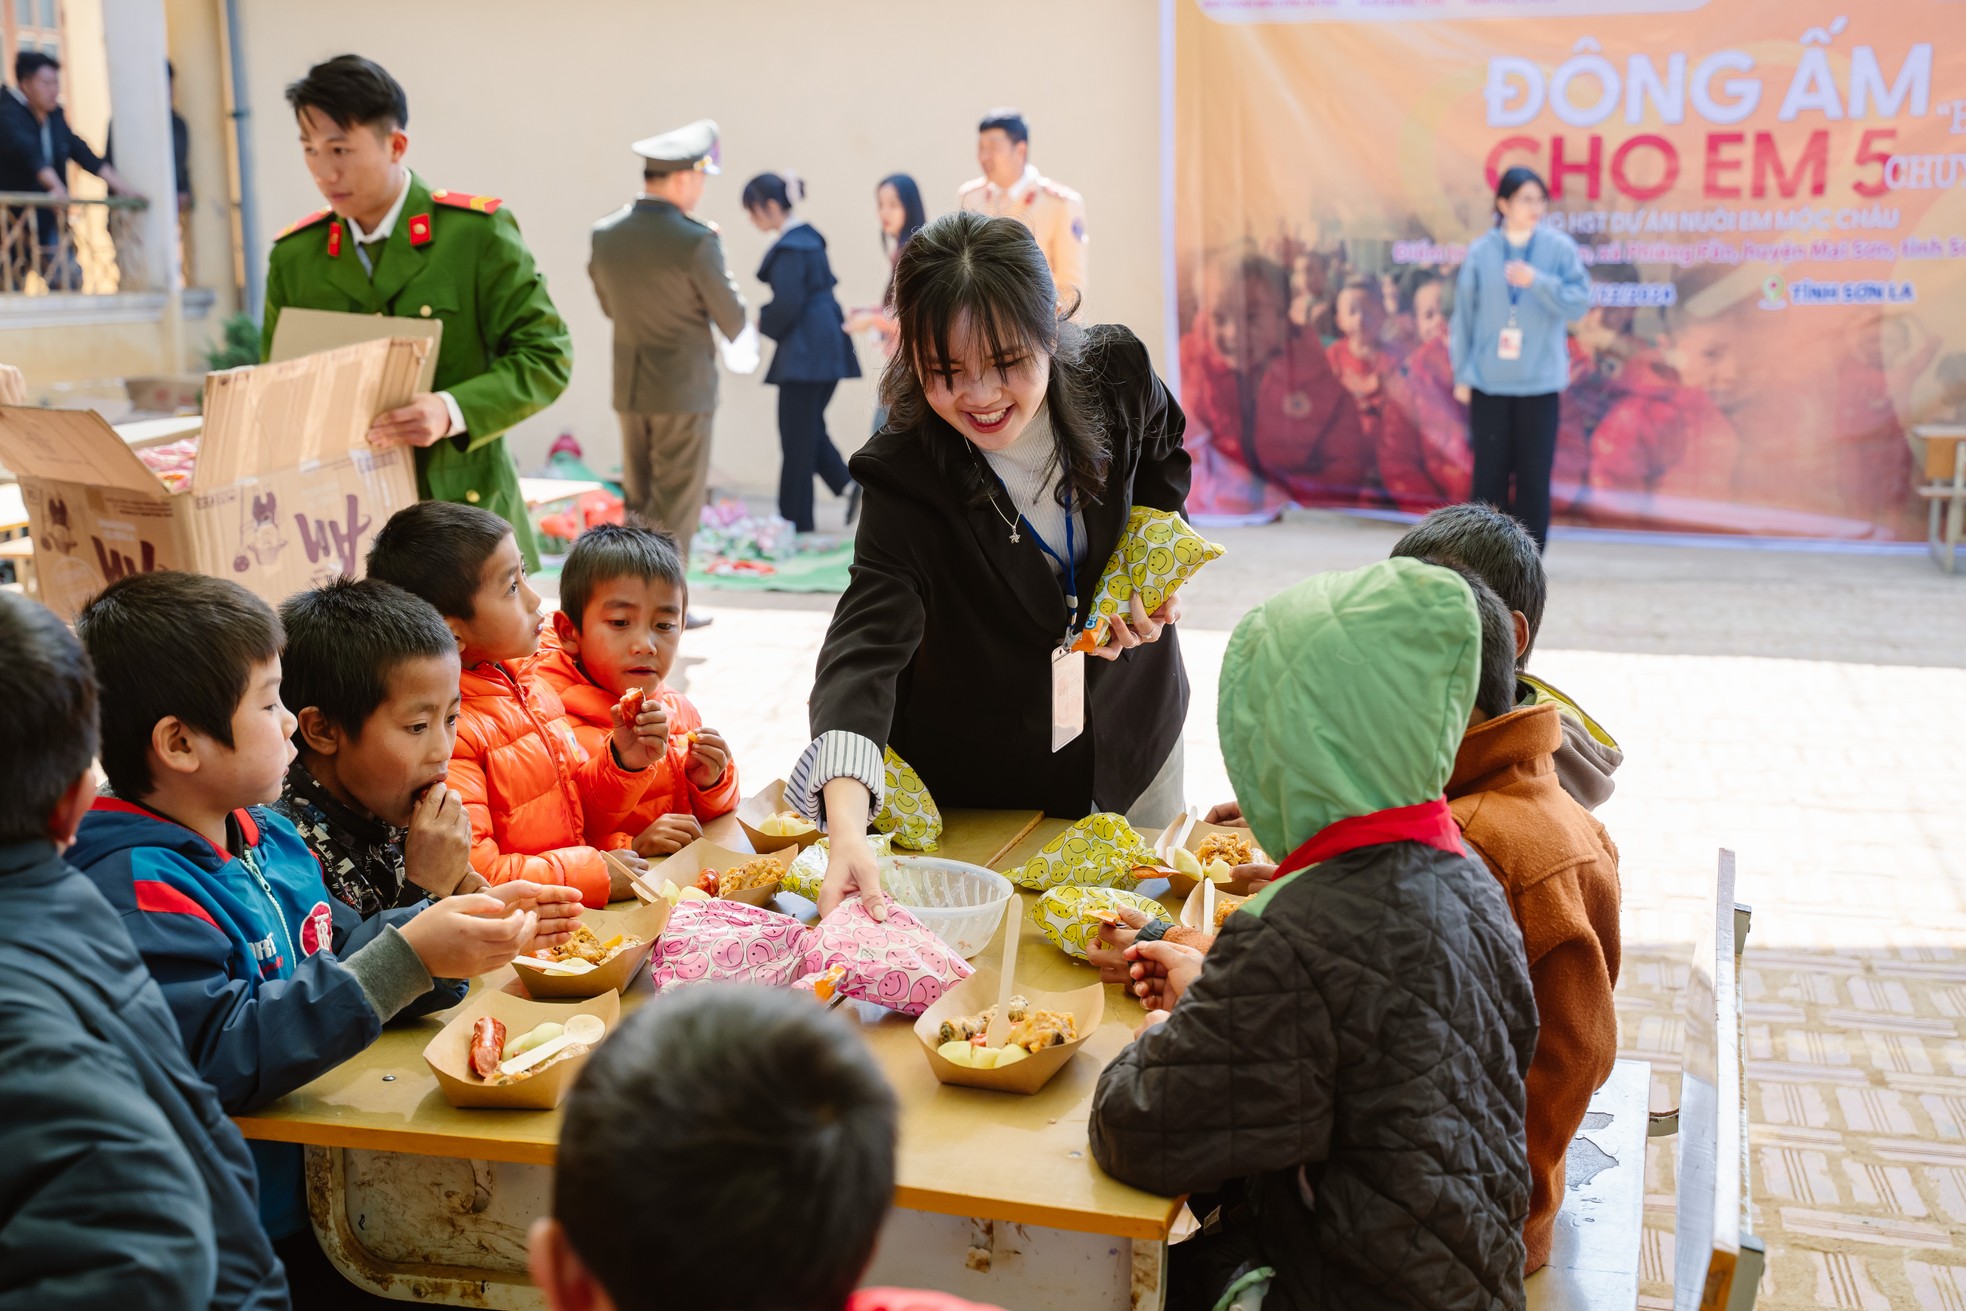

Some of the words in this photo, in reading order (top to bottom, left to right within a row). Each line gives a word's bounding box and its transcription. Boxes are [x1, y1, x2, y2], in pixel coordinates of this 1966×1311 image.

[1484, 35, 1763, 127] ĐÔNG
[1777, 16, 1934, 121] ẤM
[1484, 133, 1680, 201] CHO
[1703, 129, 1830, 200] EM
[1851, 129, 1898, 198] 5
[1679, 205, 1738, 233] NUÔI
[1739, 209, 1773, 232] EM
[1775, 203, 1833, 234] MỘC
[1834, 202, 1901, 230] CHÂU
[1743, 237, 1807, 265] huyện
[1808, 237, 1849, 262] Mai
[1841, 280, 1886, 304] SƠN
[1887, 279, 1916, 303] LA
